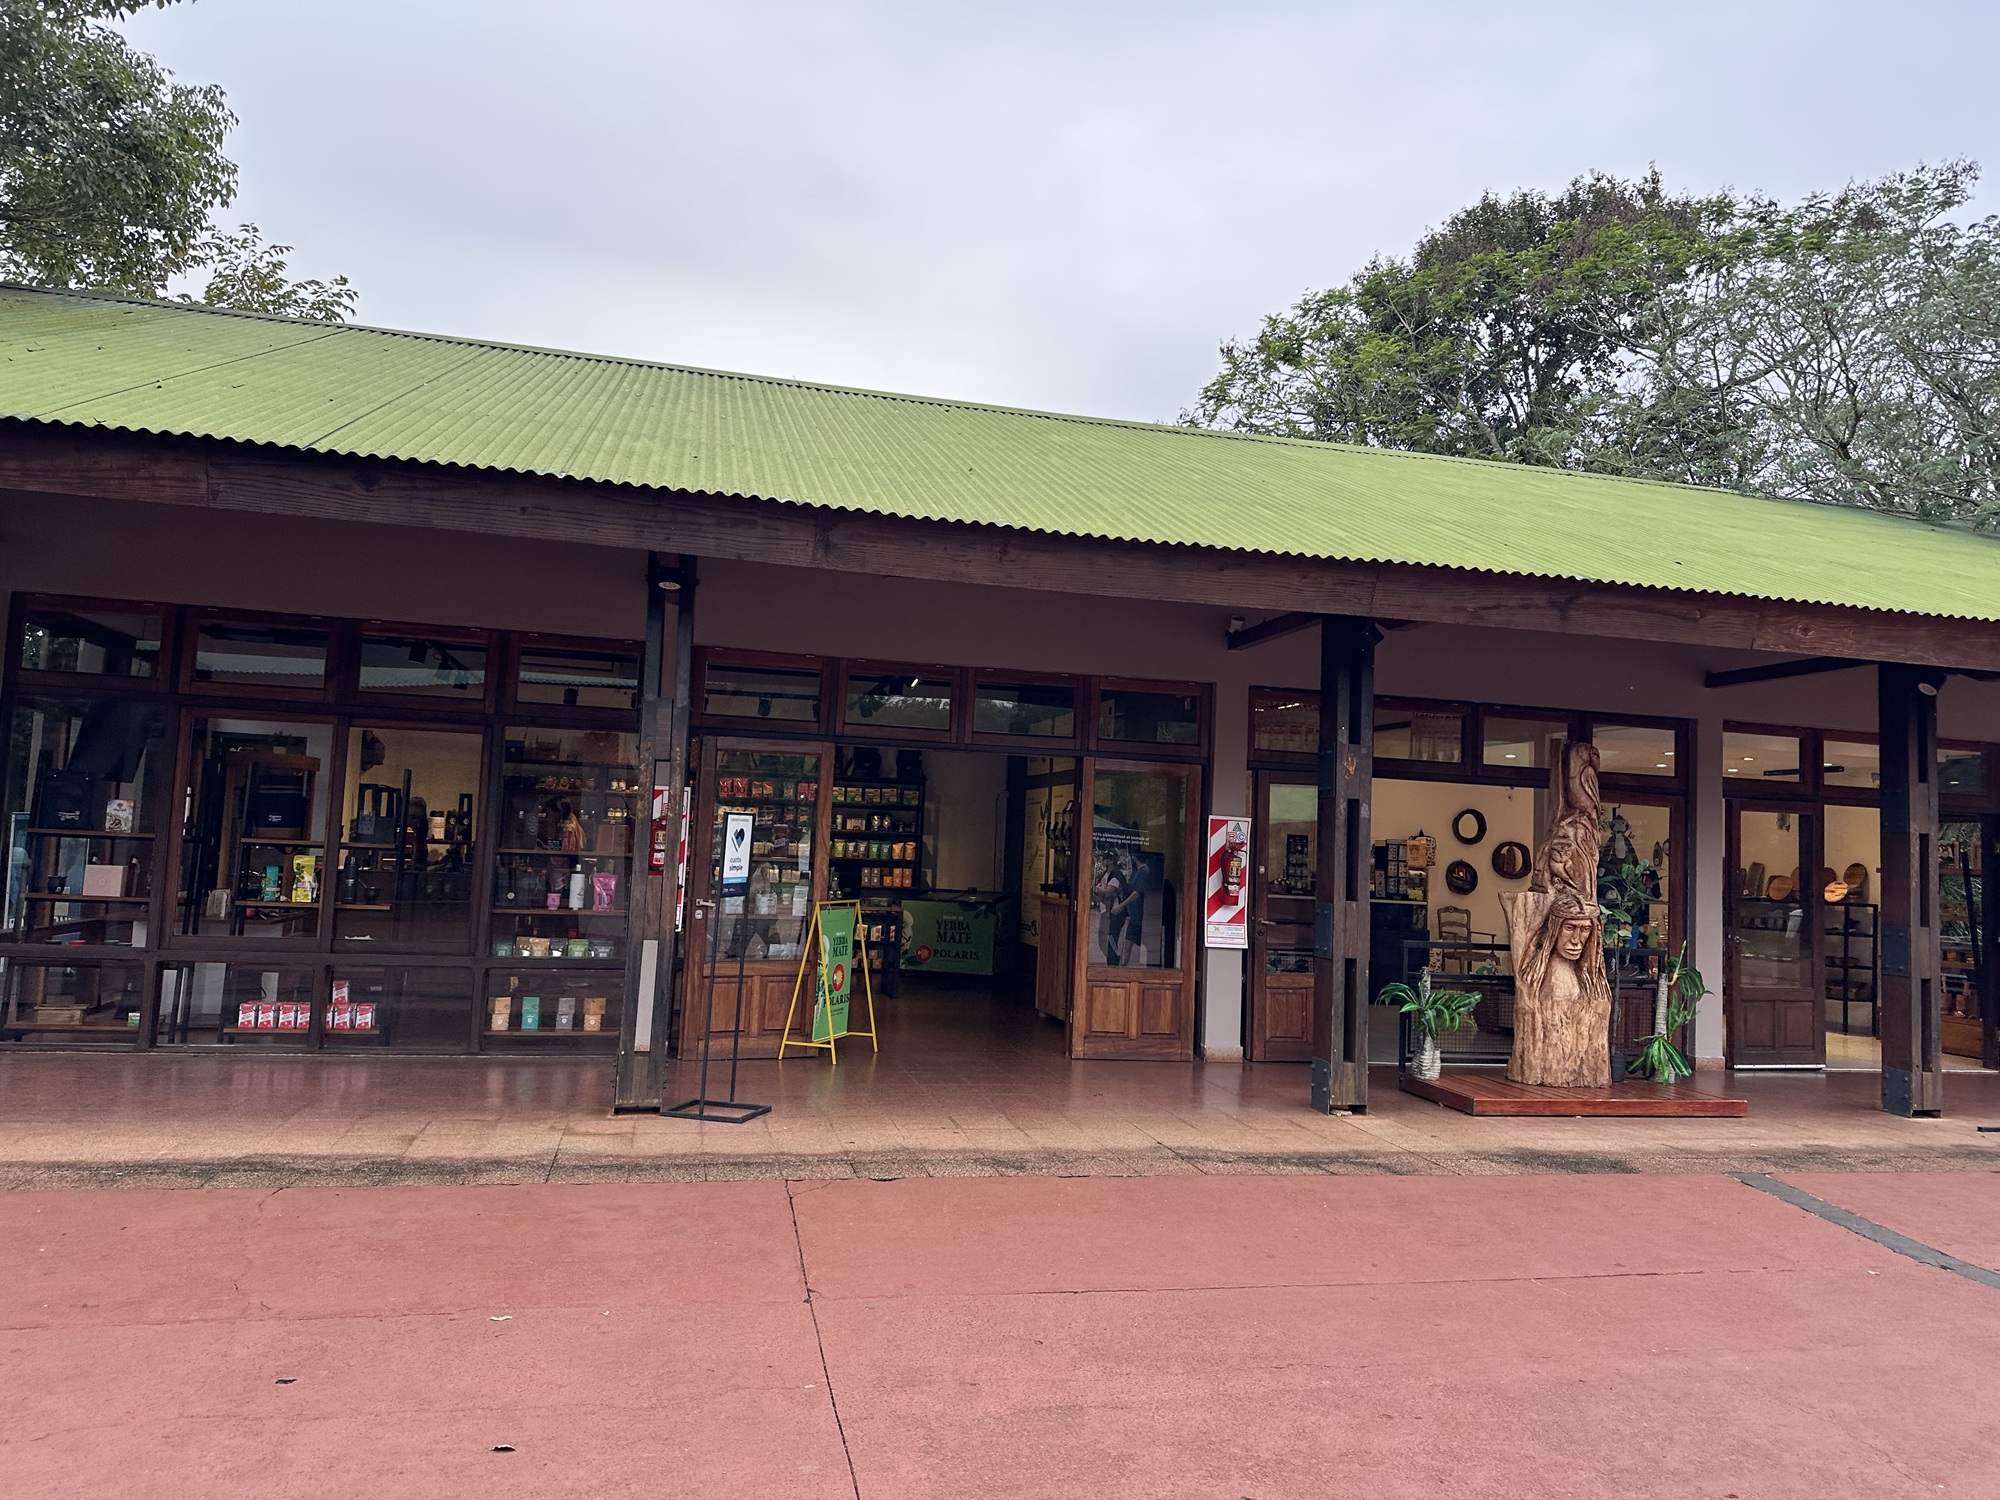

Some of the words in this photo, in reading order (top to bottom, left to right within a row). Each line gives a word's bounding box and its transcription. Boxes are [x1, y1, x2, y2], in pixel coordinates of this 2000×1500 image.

[728, 864, 743, 872] simple
[936, 919, 971, 932] YERBA
[833, 935, 848, 946] YERBA
[936, 930, 973, 944] MATE
[832, 945, 848, 957] MATE
[933, 948, 980, 961] POLARIS
